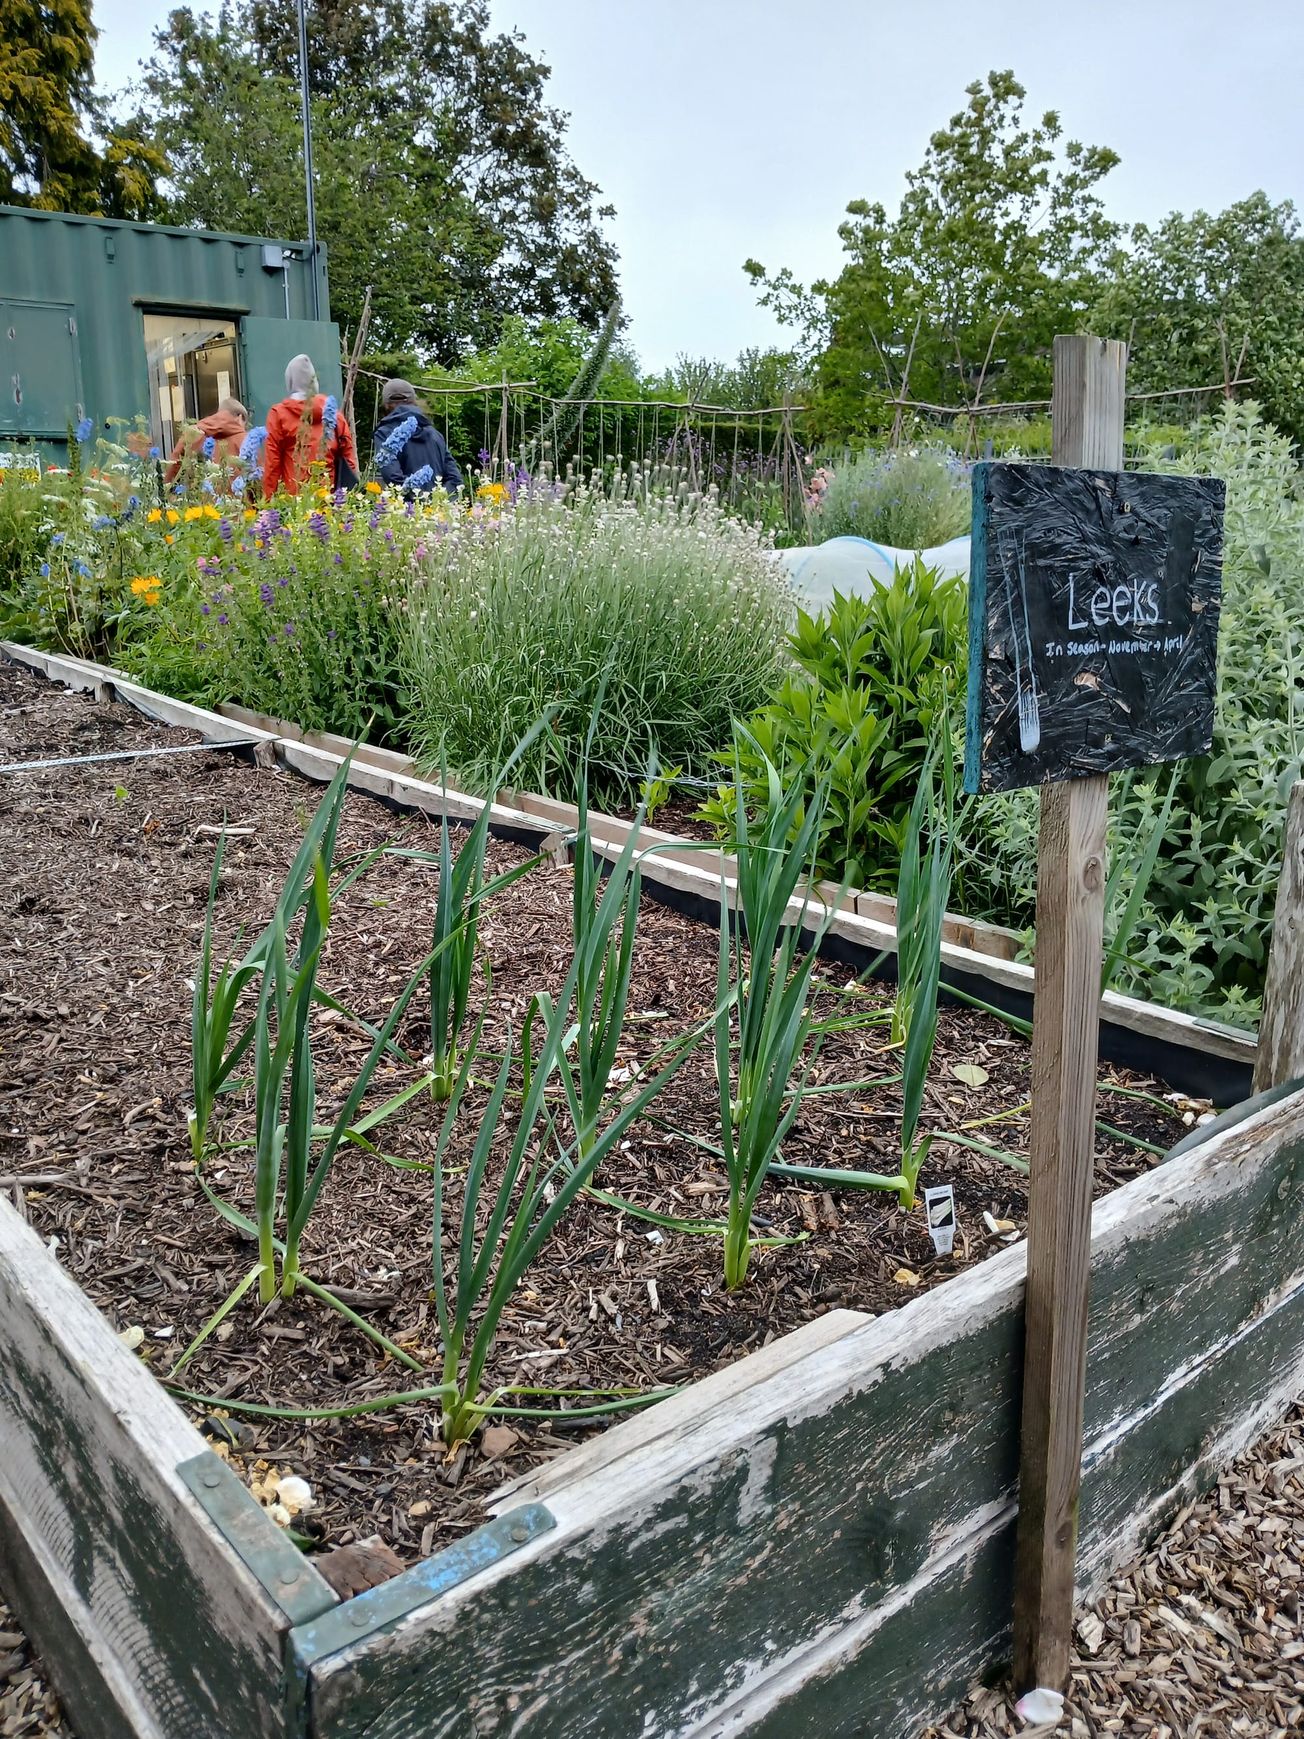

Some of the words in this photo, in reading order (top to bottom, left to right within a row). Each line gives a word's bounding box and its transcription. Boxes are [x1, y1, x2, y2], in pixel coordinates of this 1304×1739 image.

[1046, 642, 1063, 657] In
[1108, 640, 1153, 654] November
[1164, 634, 1183, 653] April
